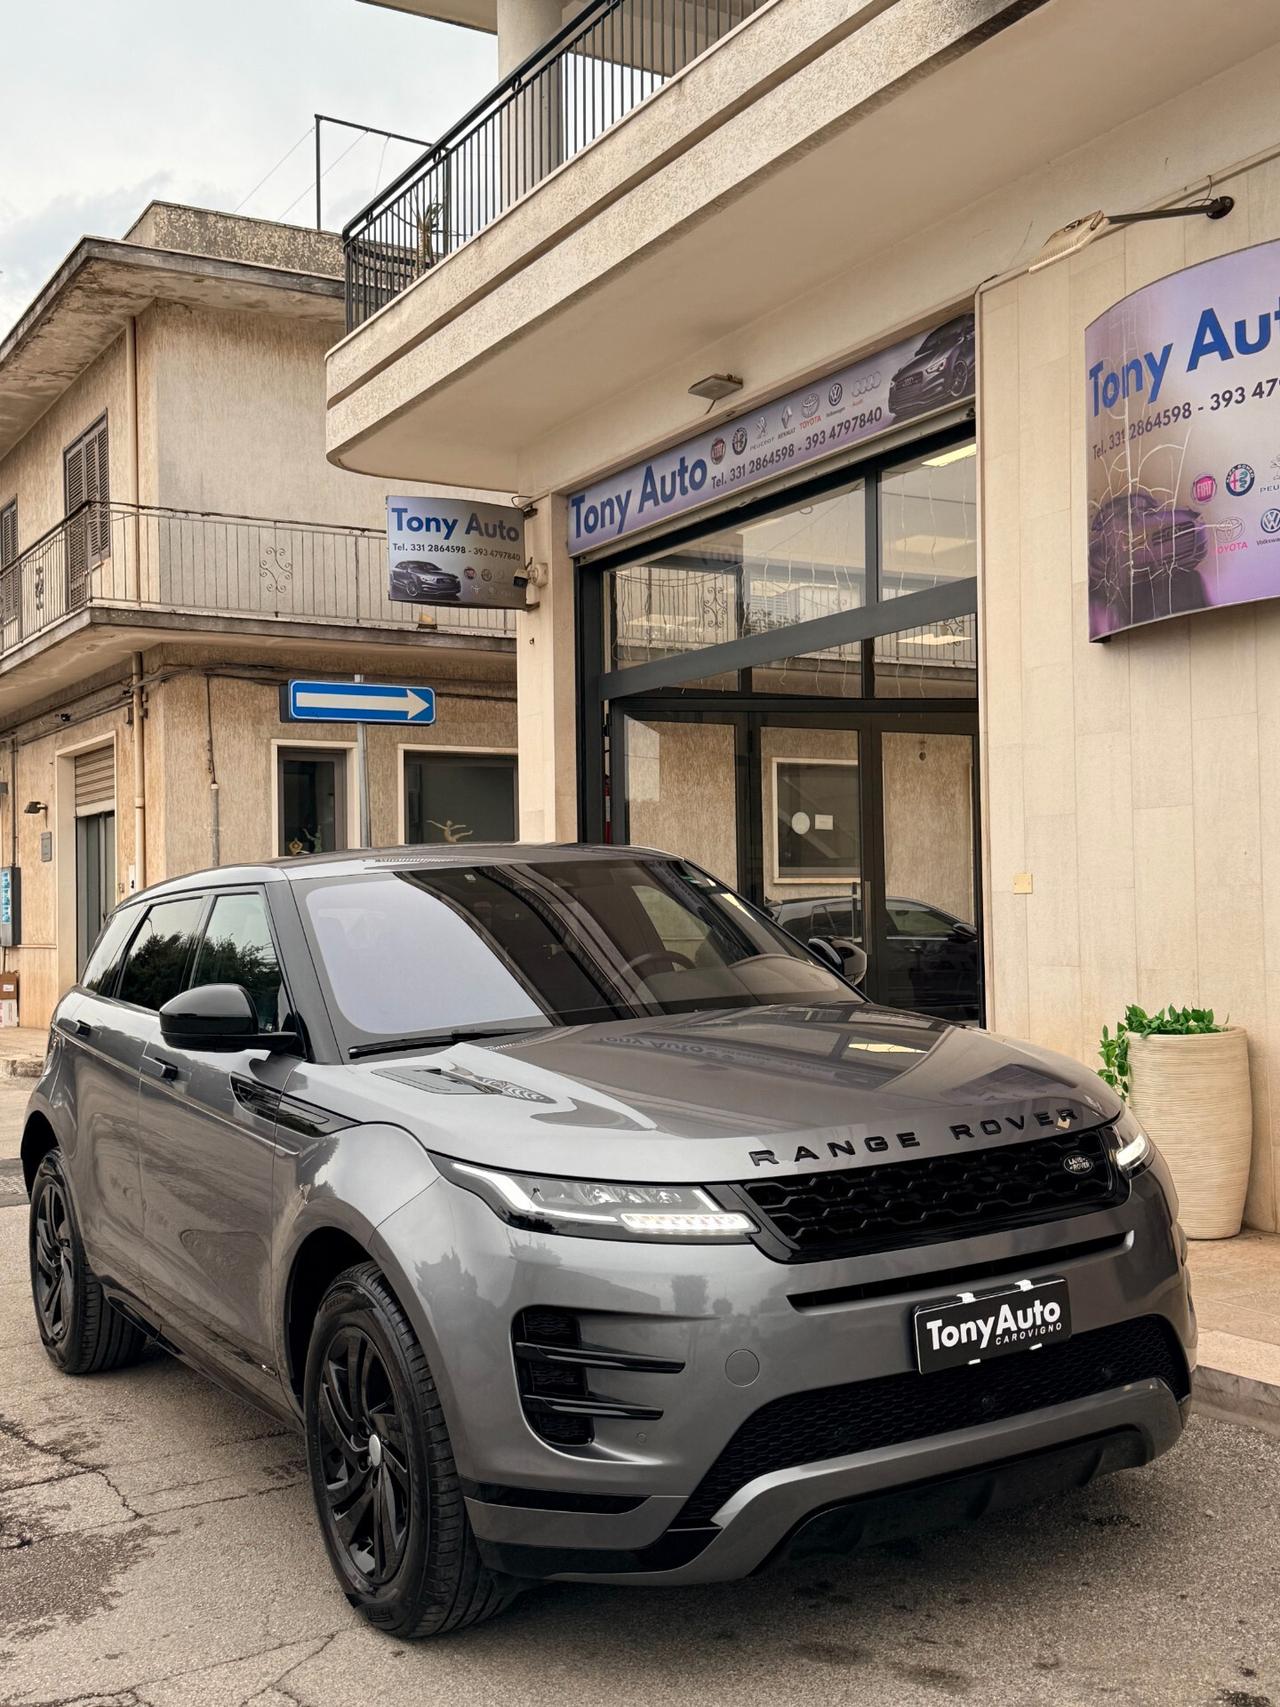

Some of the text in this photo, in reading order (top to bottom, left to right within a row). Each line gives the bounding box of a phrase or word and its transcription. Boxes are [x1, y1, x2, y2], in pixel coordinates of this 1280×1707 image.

[1089, 297, 1280, 417] Tony Au
[799, 415, 822, 430] TOYOTA
[1092, 439, 1107, 460] Tel.
[1128, 402, 1192, 441] 2864598
[1210, 386, 1246, 411] 393
[1252, 377, 1280, 400] 47
[711, 471, 728, 489] Tel.
[730, 464, 746, 482] 331
[749, 443, 795, 474] 2864598
[805, 430, 826, 451] 393
[829, 406, 883, 440] 4797840
[571, 455, 708, 539] Tony Auto
[391, 507, 520, 543] Tony Auto
[393, 543, 408, 552] Tel.
[410, 543, 425, 552] 331
[427, 544, 467, 554] 2864598
[473, 547, 488, 557] 393
[1216, 541, 1249, 554] OYOTA
[748, 1108, 1079, 1167] RANGE ROVER
[926, 1299, 1061, 1350] TonyAuto
[995, 1322, 1063, 1345] CAROVIGNO
